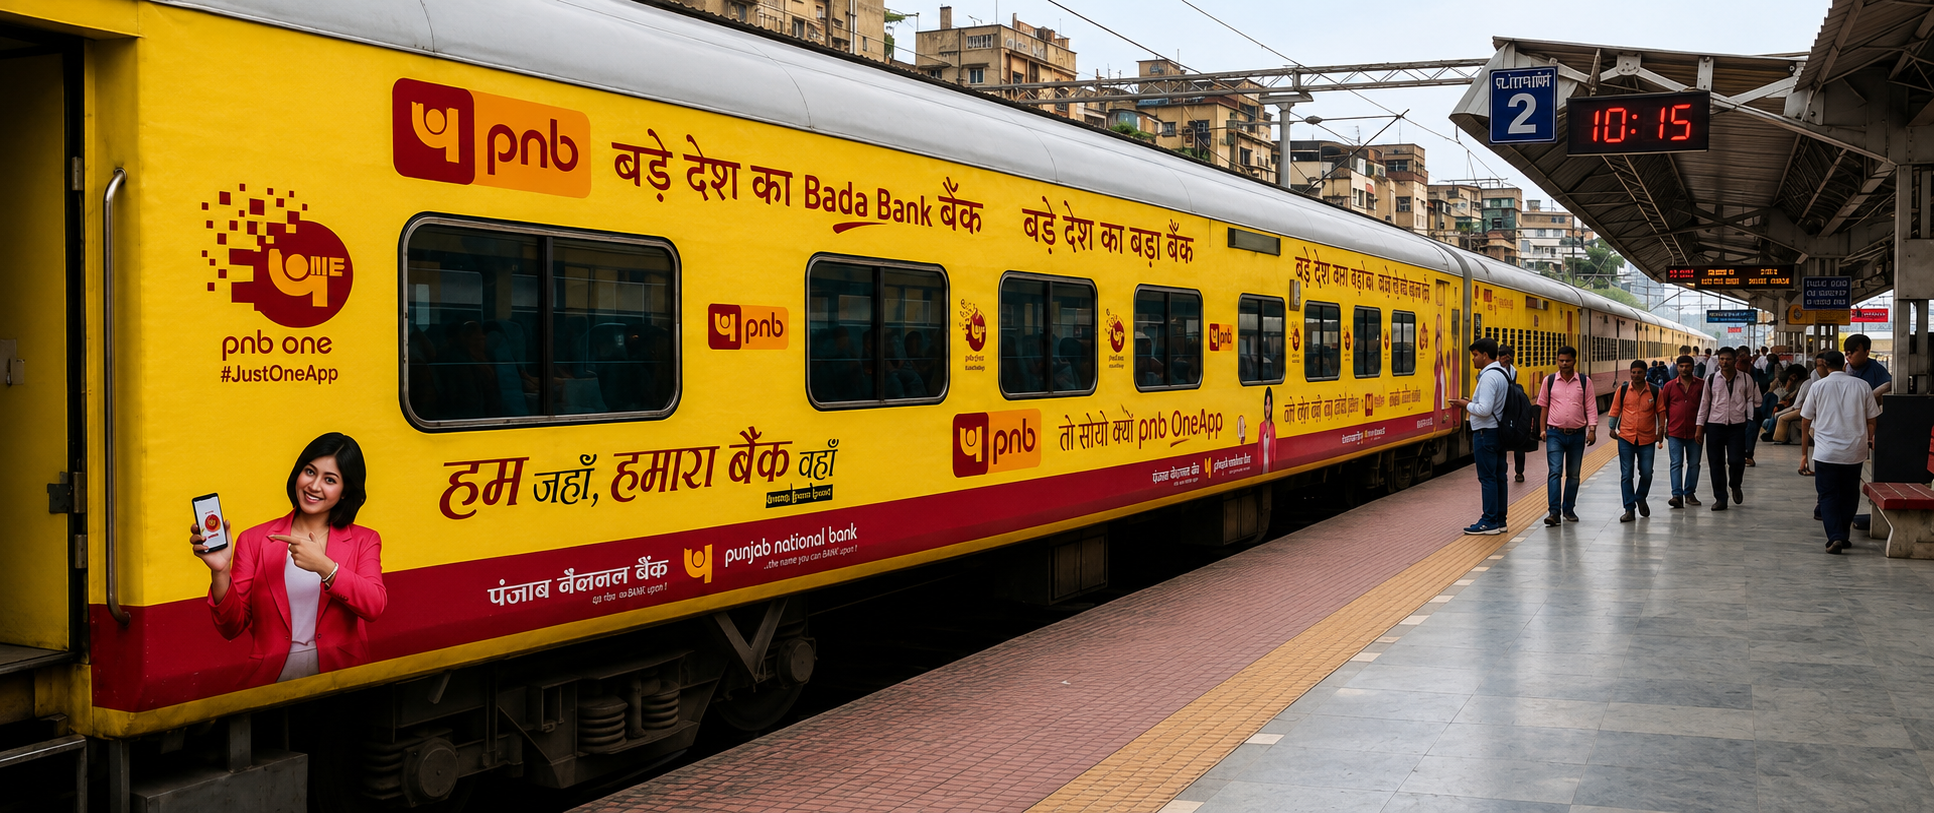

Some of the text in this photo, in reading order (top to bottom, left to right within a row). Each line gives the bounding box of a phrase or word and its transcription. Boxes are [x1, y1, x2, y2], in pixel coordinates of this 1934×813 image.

[1507, 93, 1537, 134] 2
[1593, 104, 1691, 143] 10:15
[487, 118, 579, 176] pnb
[611, 128, 674, 203] बड़े
[683, 134, 741, 201] देश
[750, 165, 793, 207] का
[804, 174, 868, 218] Bada
[876, 187, 933, 227] Bank
[1021, 195, 1056, 255] बड़े
[1062, 200, 1094, 253] देश
[1100, 221, 1124, 254] का
[1129, 226, 1162, 268] बड़ा
[222, 329, 333, 361] pnb one
[745, 311, 784, 344] pnb
[220, 364, 339, 385] #JustOneApp
[992, 418, 1036, 466] pnb
[1058, 414, 1076, 452] तो
[1138, 411, 1167, 450] pnb
[1171, 408, 1223, 440] OneApp
[438, 456, 530, 521] हम
[610, 445, 721, 503] हमारा
[798, 438, 840, 481] वहाँ
[724, 522, 858, 568] punjab national bank
[487, 578, 552, 607] पंजाब
